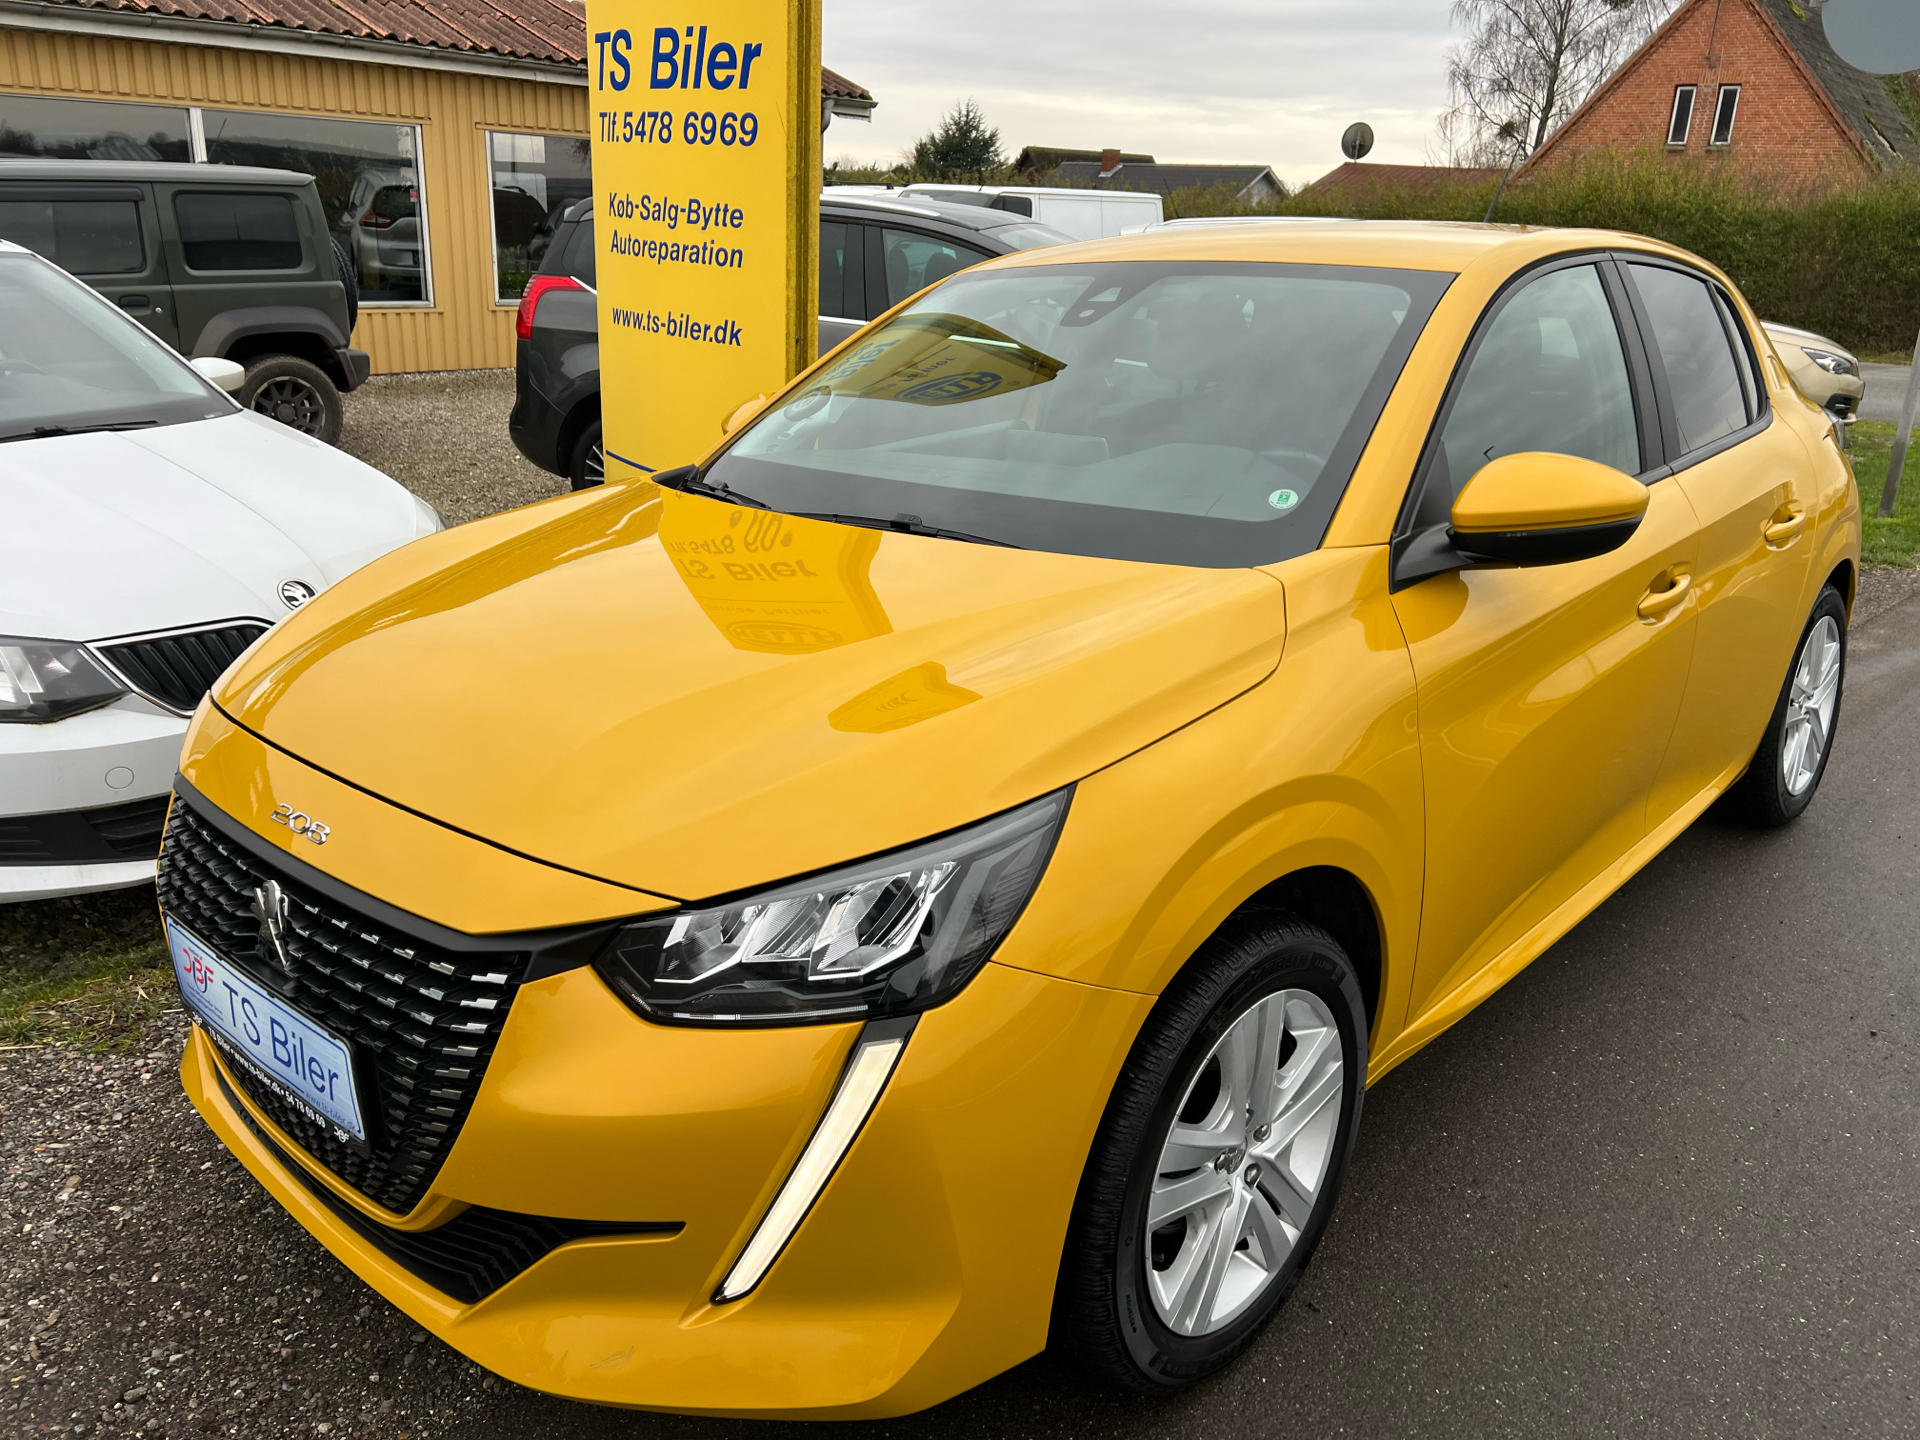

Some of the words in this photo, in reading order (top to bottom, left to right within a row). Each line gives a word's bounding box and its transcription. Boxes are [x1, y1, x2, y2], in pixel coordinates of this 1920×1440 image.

[594, 29, 632, 92] TS
[649, 25, 763, 91] Biler
[683, 111, 759, 147] 6969
[608, 192, 744, 231] Køb-Salg-Bytte
[610, 229, 744, 269] Autoreparation
[612, 306, 743, 347] www.ts-biler.dk
[270, 802, 331, 845] 208
[222, 979, 260, 1046] TS
[269, 1015, 339, 1102] Biler
